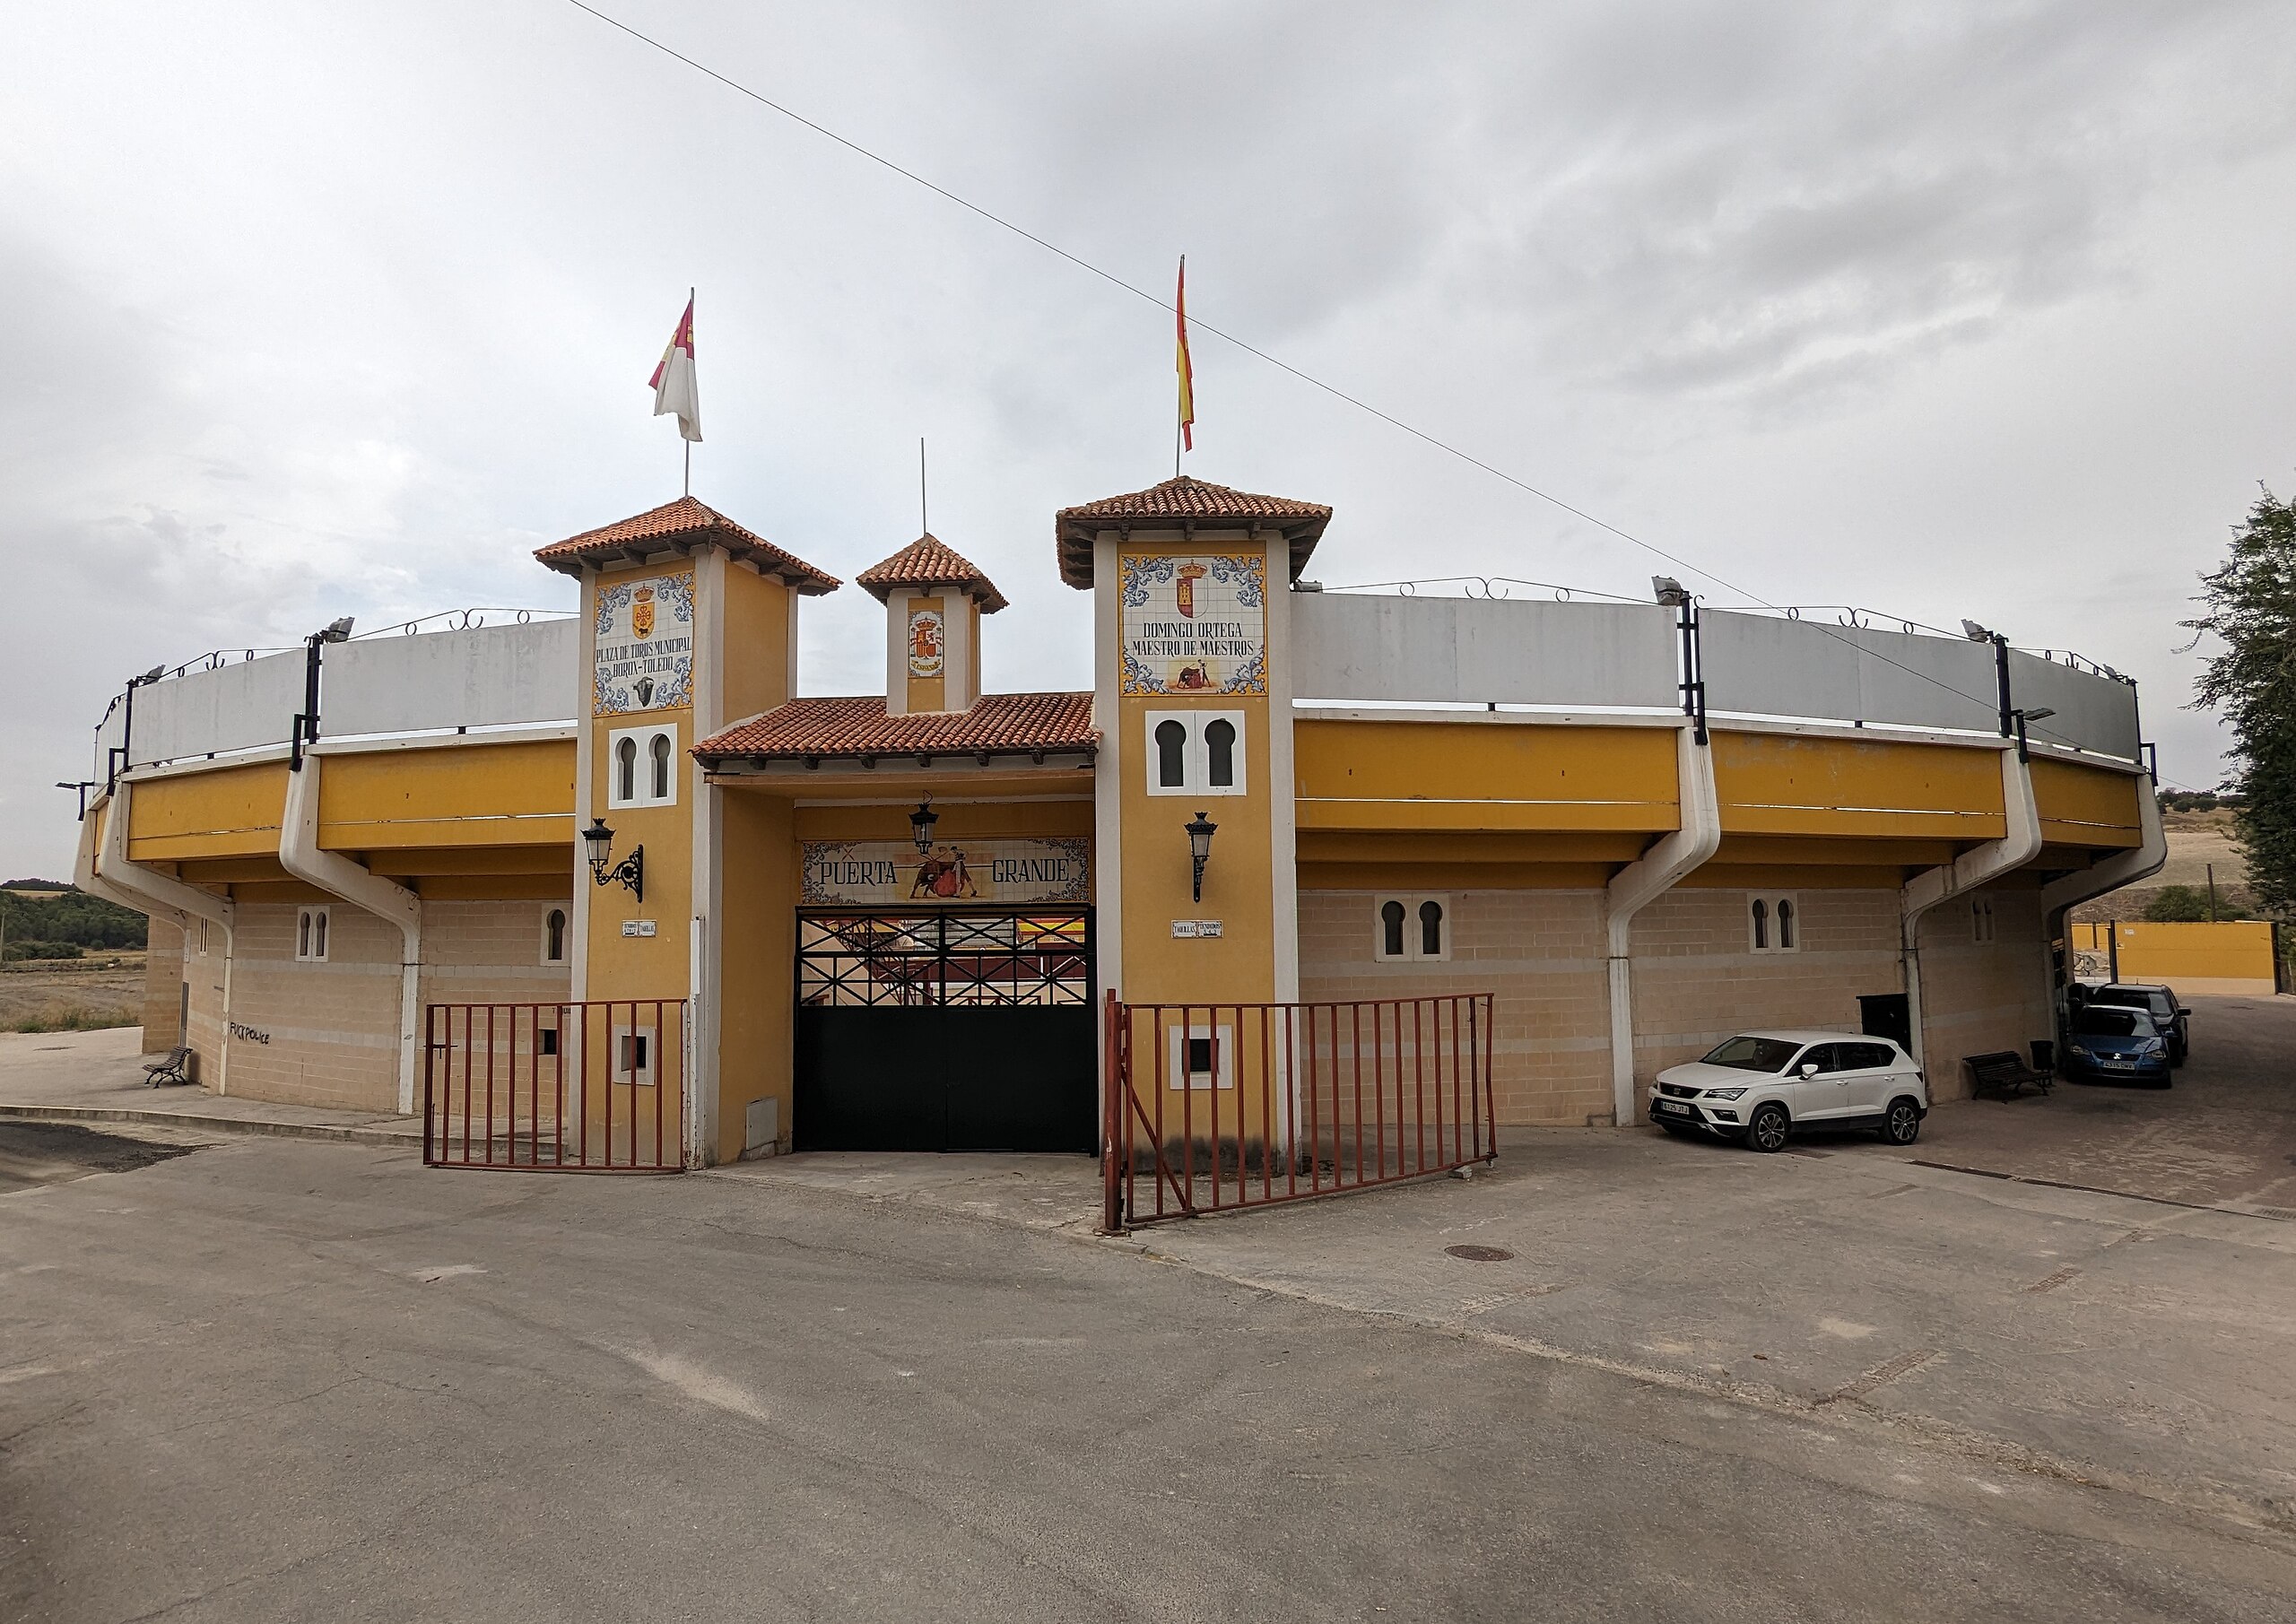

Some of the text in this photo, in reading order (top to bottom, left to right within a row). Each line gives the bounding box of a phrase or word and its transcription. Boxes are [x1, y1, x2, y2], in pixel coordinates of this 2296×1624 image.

[1144, 622, 1242, 639] DOMINGO ORTEGA
[596, 637, 691, 663] PLAZA DE TOROS MUNICIPAL
[1133, 640, 1254, 658] MAESTRO DE MAESTROS
[818, 858, 1070, 886] PUERTA GRANDE
